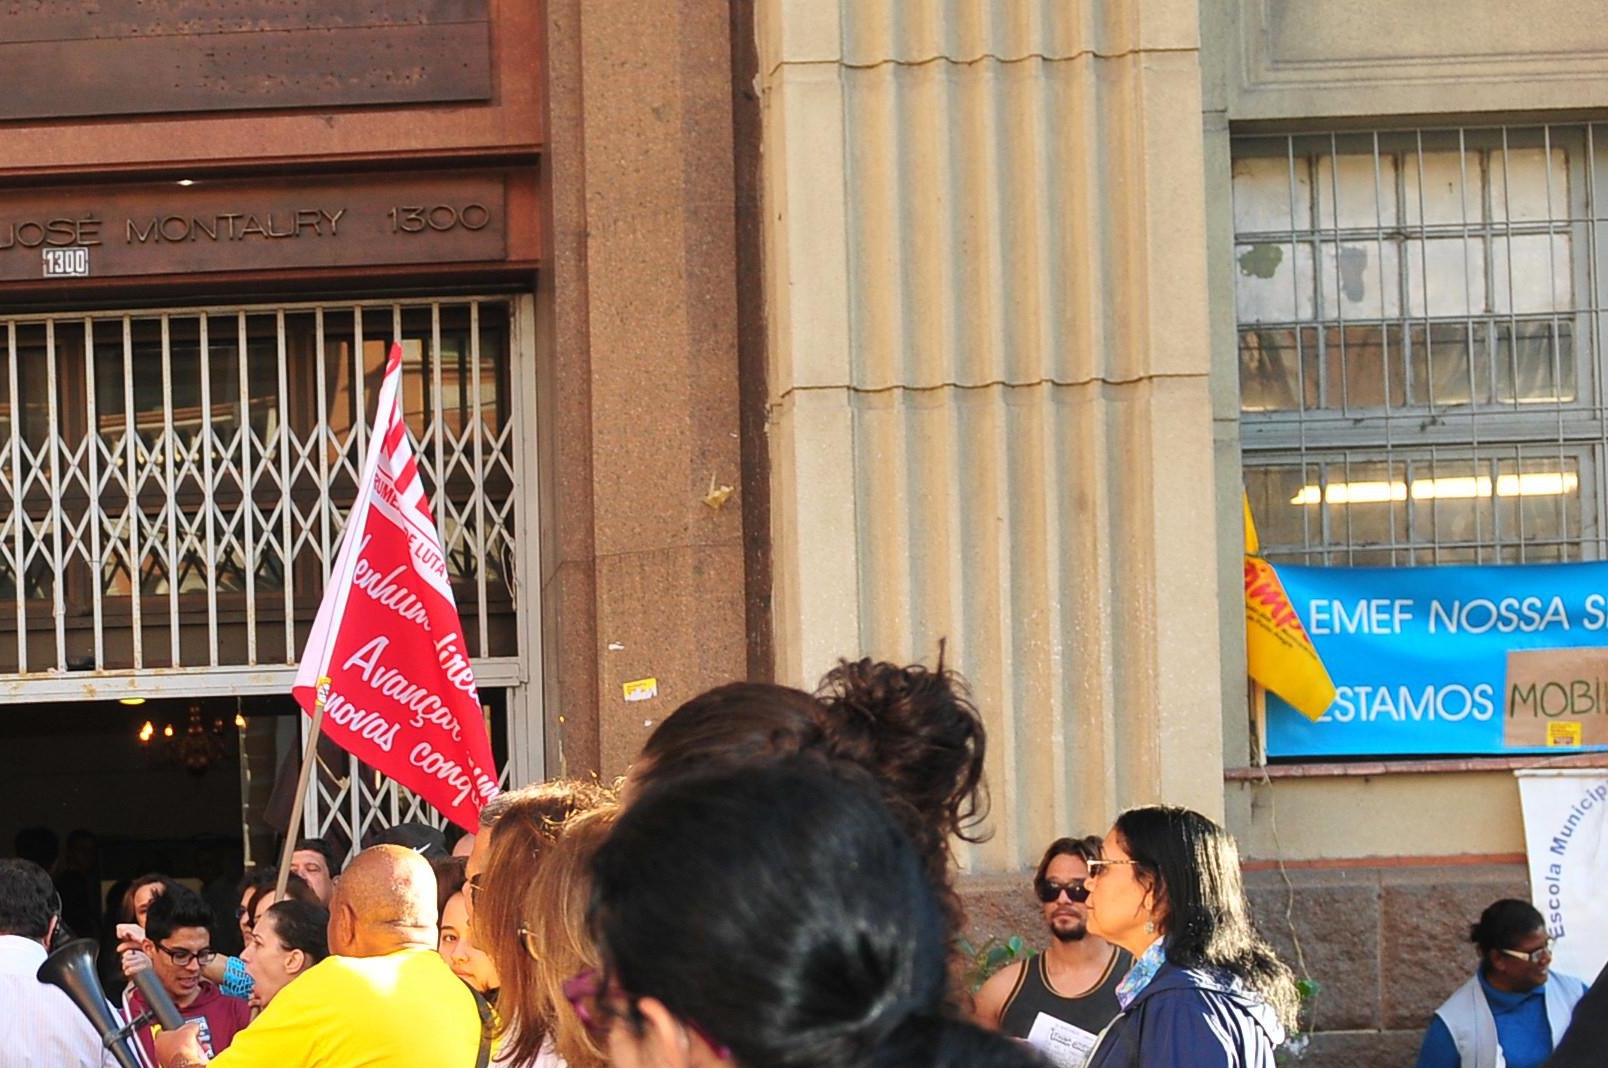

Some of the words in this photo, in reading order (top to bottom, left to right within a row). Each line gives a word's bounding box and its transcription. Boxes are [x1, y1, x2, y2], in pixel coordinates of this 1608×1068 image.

[125, 206, 347, 245] MONTAURY
[387, 203, 490, 235] 1300
[45, 250, 87, 275] 1300
[414, 543, 447, 578] LUTA
[1309, 598, 1414, 635] EMEF
[1428, 596, 1570, 635] NOSSA
[1582, 593, 1608, 632] S
[342, 635, 462, 742] Avançar
[1316, 683, 1494, 723] STAMOS
[1509, 676, 1608, 719] MOBI
[323, 691, 401, 752] novas
[1549, 780, 1608, 857] Municip
[1545, 862, 1567, 942] Escola
